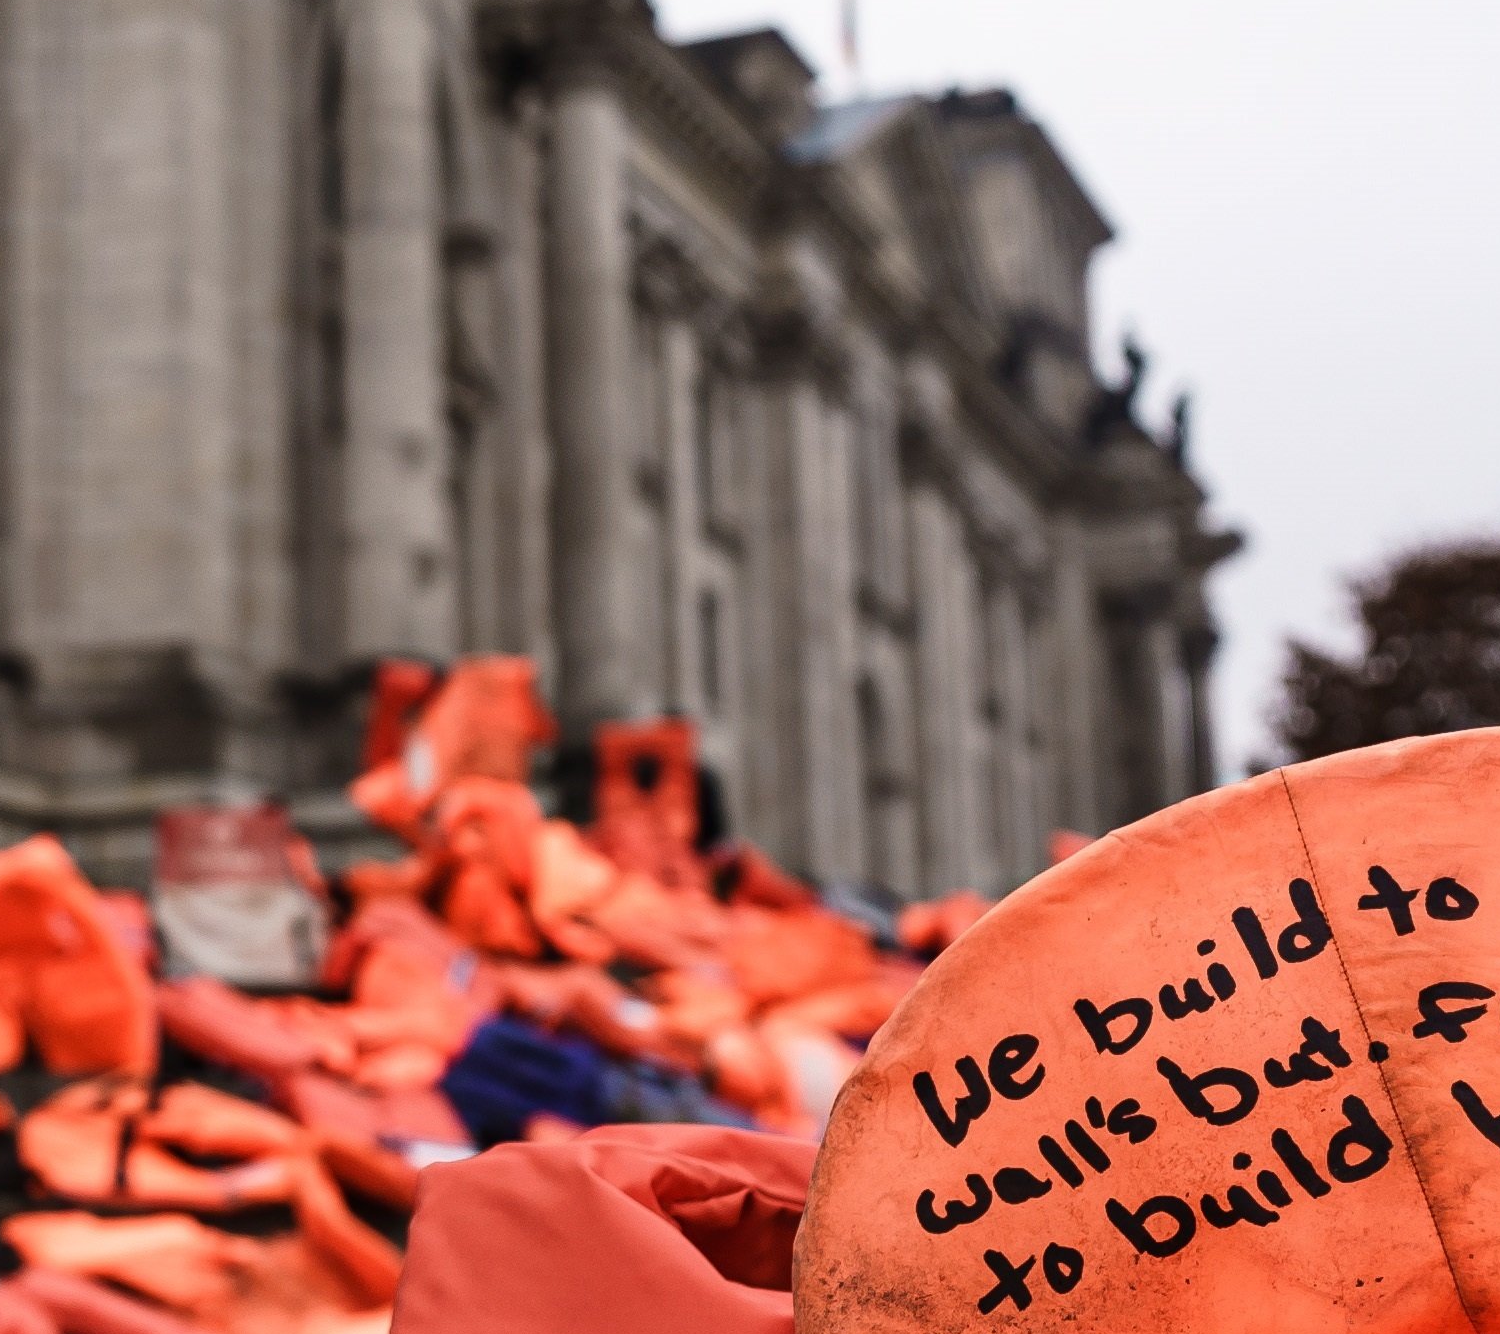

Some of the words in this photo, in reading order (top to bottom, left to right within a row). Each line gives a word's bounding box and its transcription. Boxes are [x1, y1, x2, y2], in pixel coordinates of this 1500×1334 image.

[912, 1031, 1047, 1149] We
[1072, 876, 1335, 1057] build
[1356, 864, 1481, 937] to
[976, 1241, 1085, 1317] to
[1104, 1093, 1395, 1259] build
